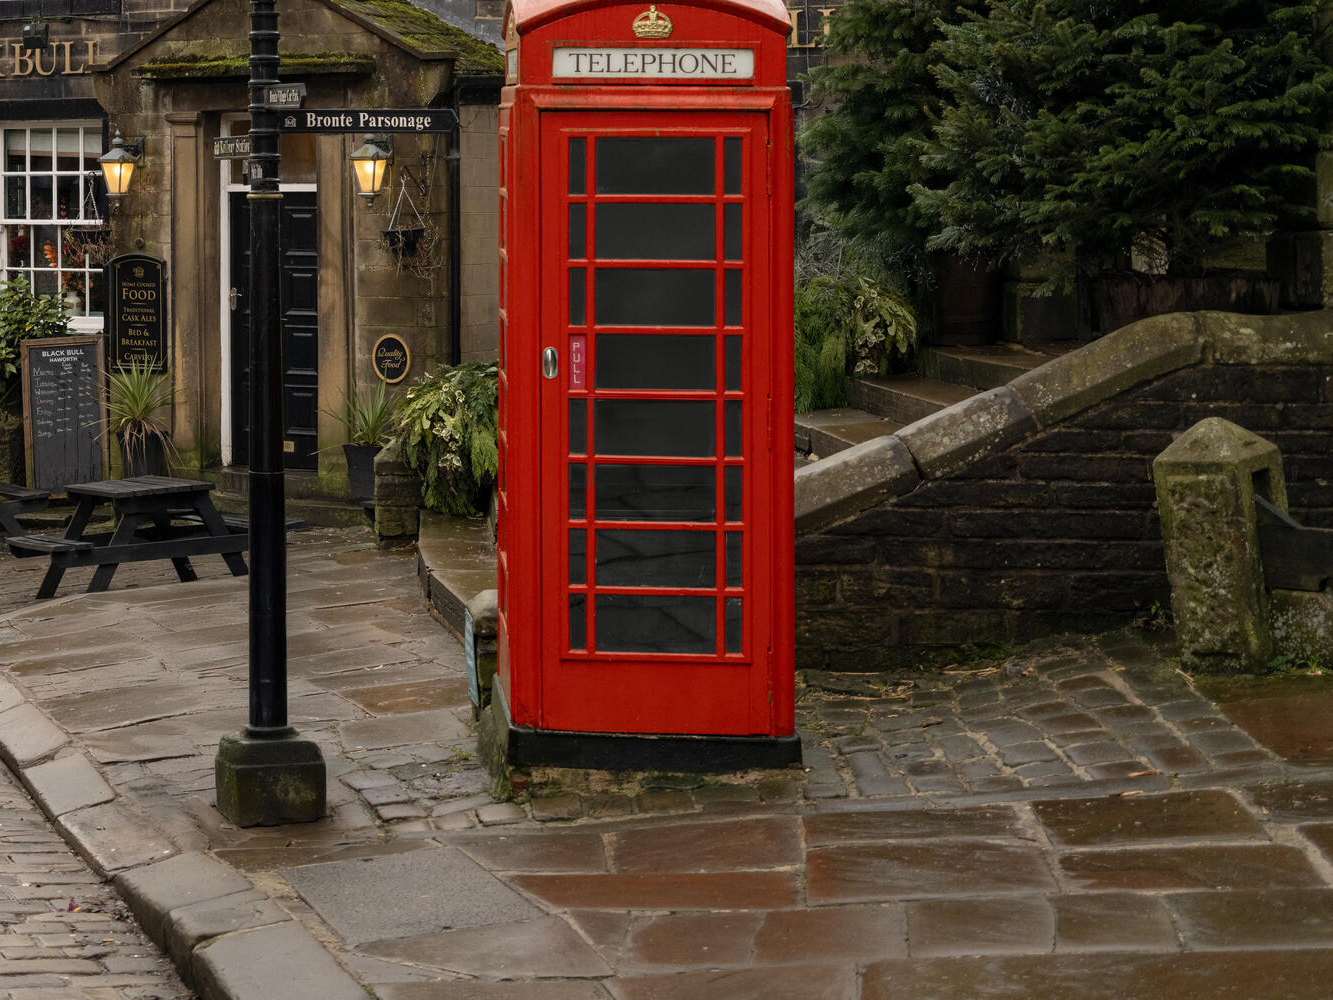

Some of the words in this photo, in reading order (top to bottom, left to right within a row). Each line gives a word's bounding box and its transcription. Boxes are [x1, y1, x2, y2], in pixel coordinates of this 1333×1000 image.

[11, 40, 98, 76] BULL
[568, 53, 737, 74] TELEPHONE
[306, 112, 353, 128] Bronte
[359, 112, 432, 131] Parsonage
[122, 288, 156, 300] FOOD
[143, 329, 150, 337] &
[121, 338, 157, 347] BREAKFAST
[42, 349, 65, 357] BLACK
[66, 348, 85, 356] BULL
[377, 347, 405, 362] Quality
[381, 359, 402, 369] Food
[572, 342, 581, 384] PULL
